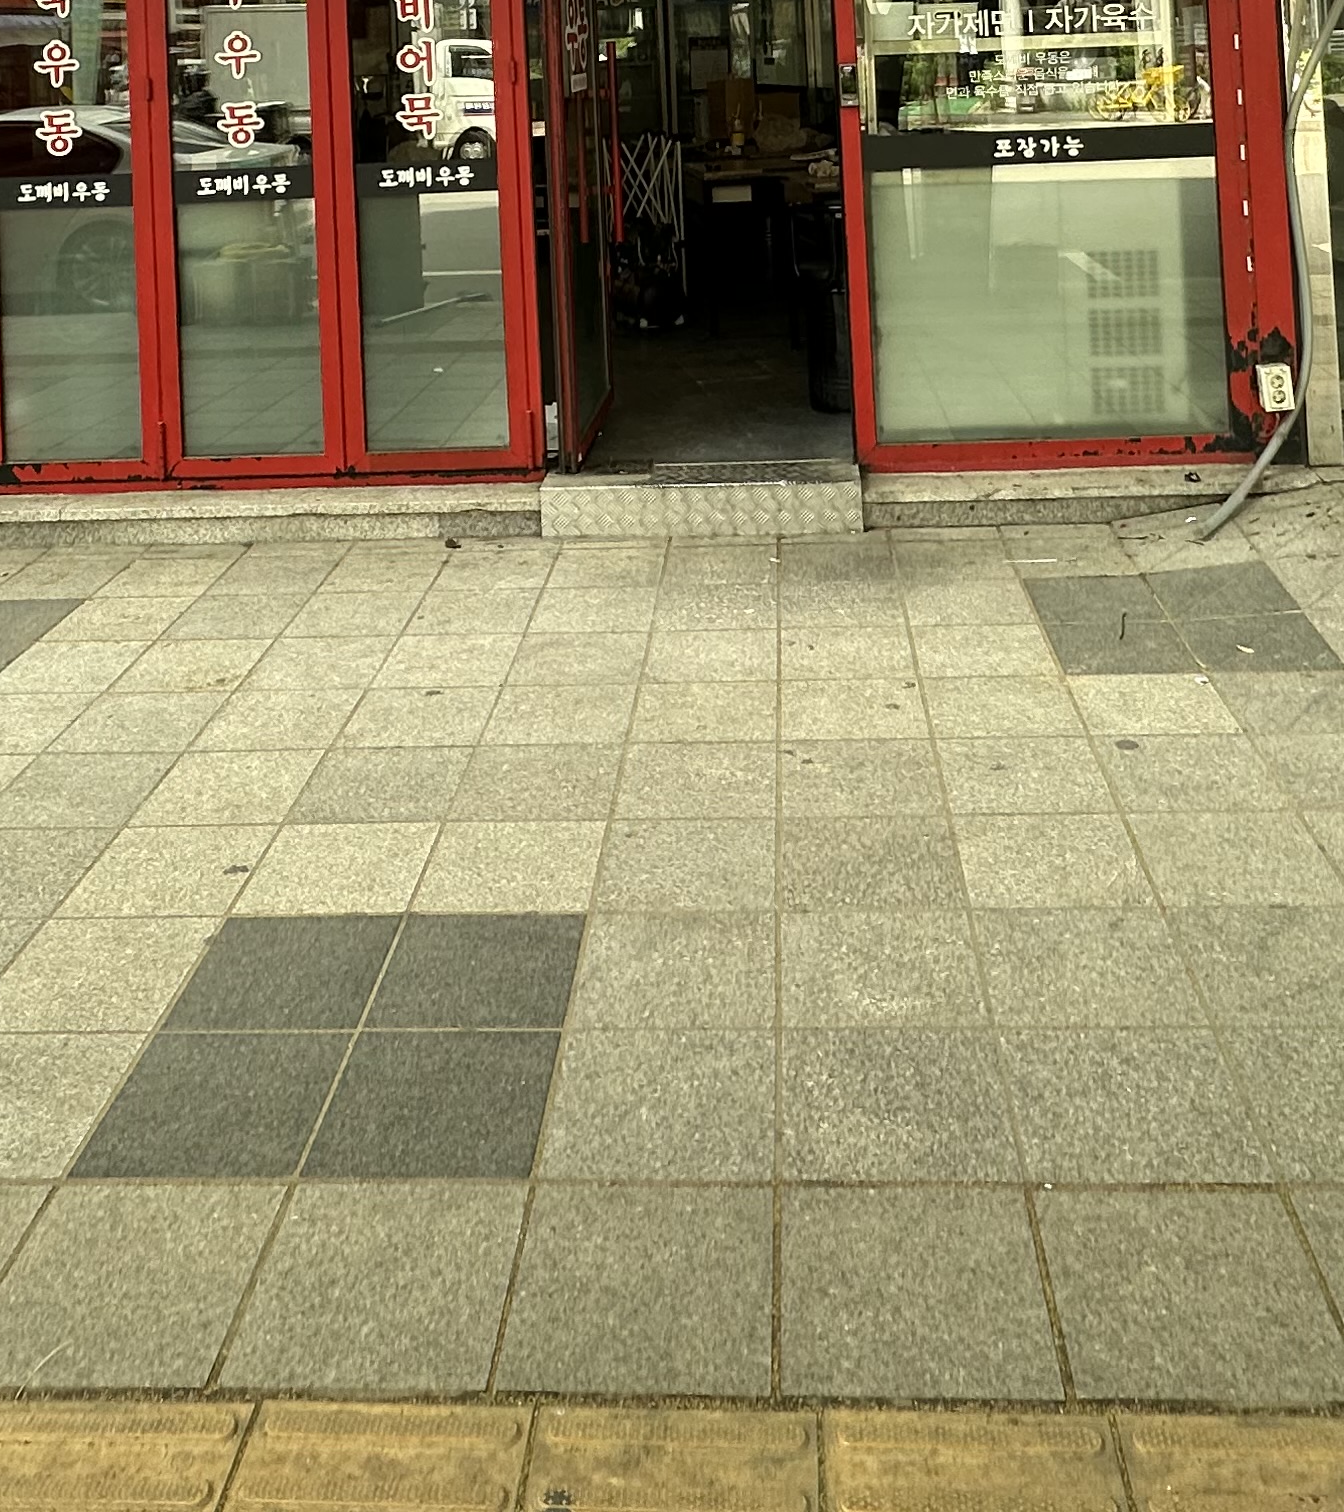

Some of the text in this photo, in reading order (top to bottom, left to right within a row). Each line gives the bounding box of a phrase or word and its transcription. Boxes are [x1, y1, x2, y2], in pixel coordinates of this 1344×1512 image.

[1045, 3, 1156, 33] 자가육수
[993, 134, 1085, 159] 포장가능
[197, 173, 291, 197] 도깨비 우동
[378, 165, 475, 188] 도깨비 우동
[17, 181, 111, 203] 도깨비 우동
